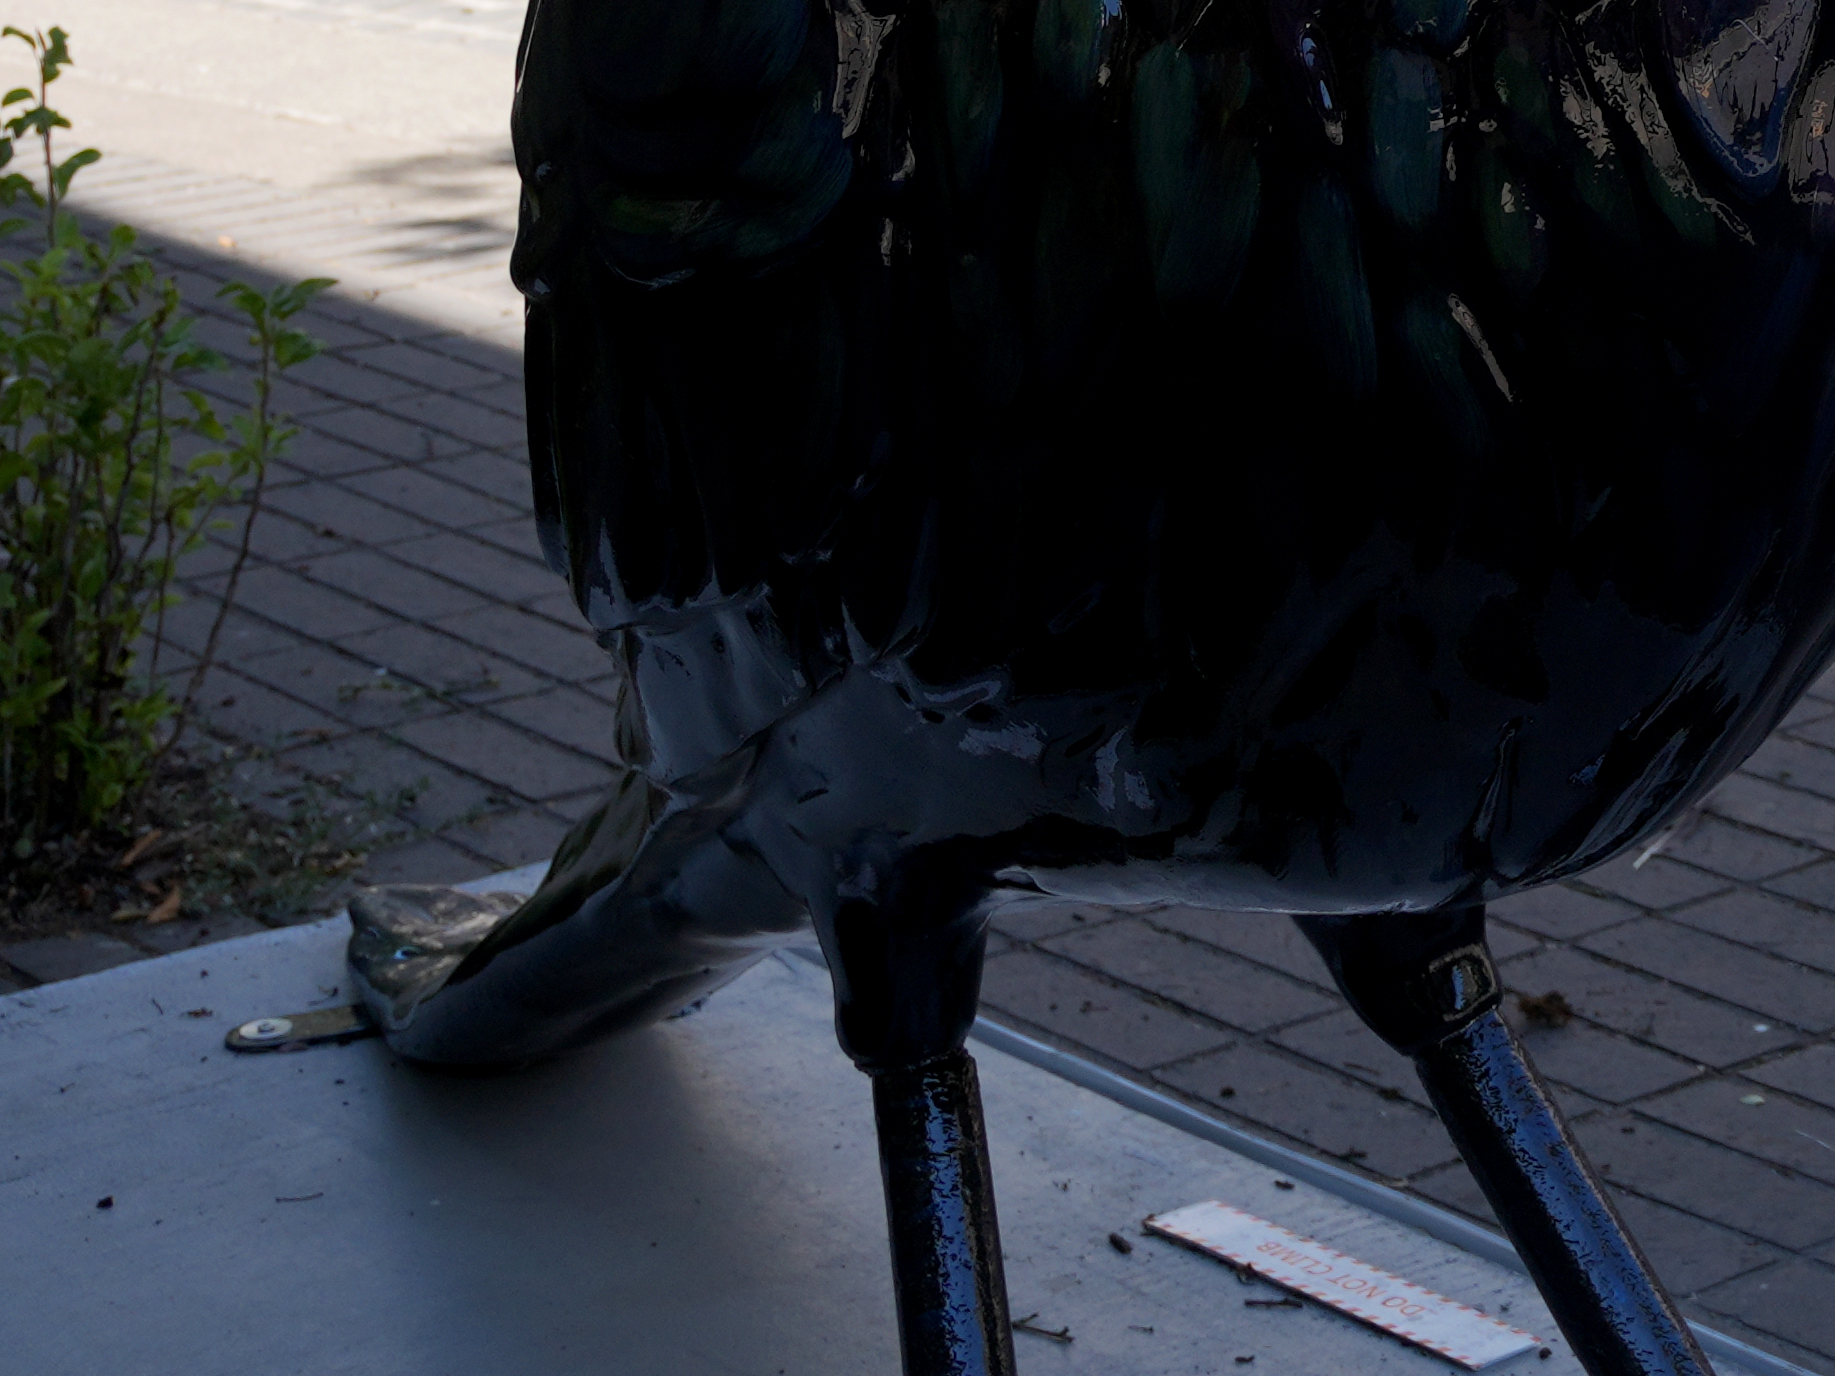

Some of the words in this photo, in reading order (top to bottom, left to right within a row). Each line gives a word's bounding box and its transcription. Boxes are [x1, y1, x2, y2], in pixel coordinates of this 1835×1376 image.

[1256, 1241, 1333, 1275] CLIMB
[1325, 1274, 1388, 1299] NOT
[1381, 1296, 1426, 1317] DO
